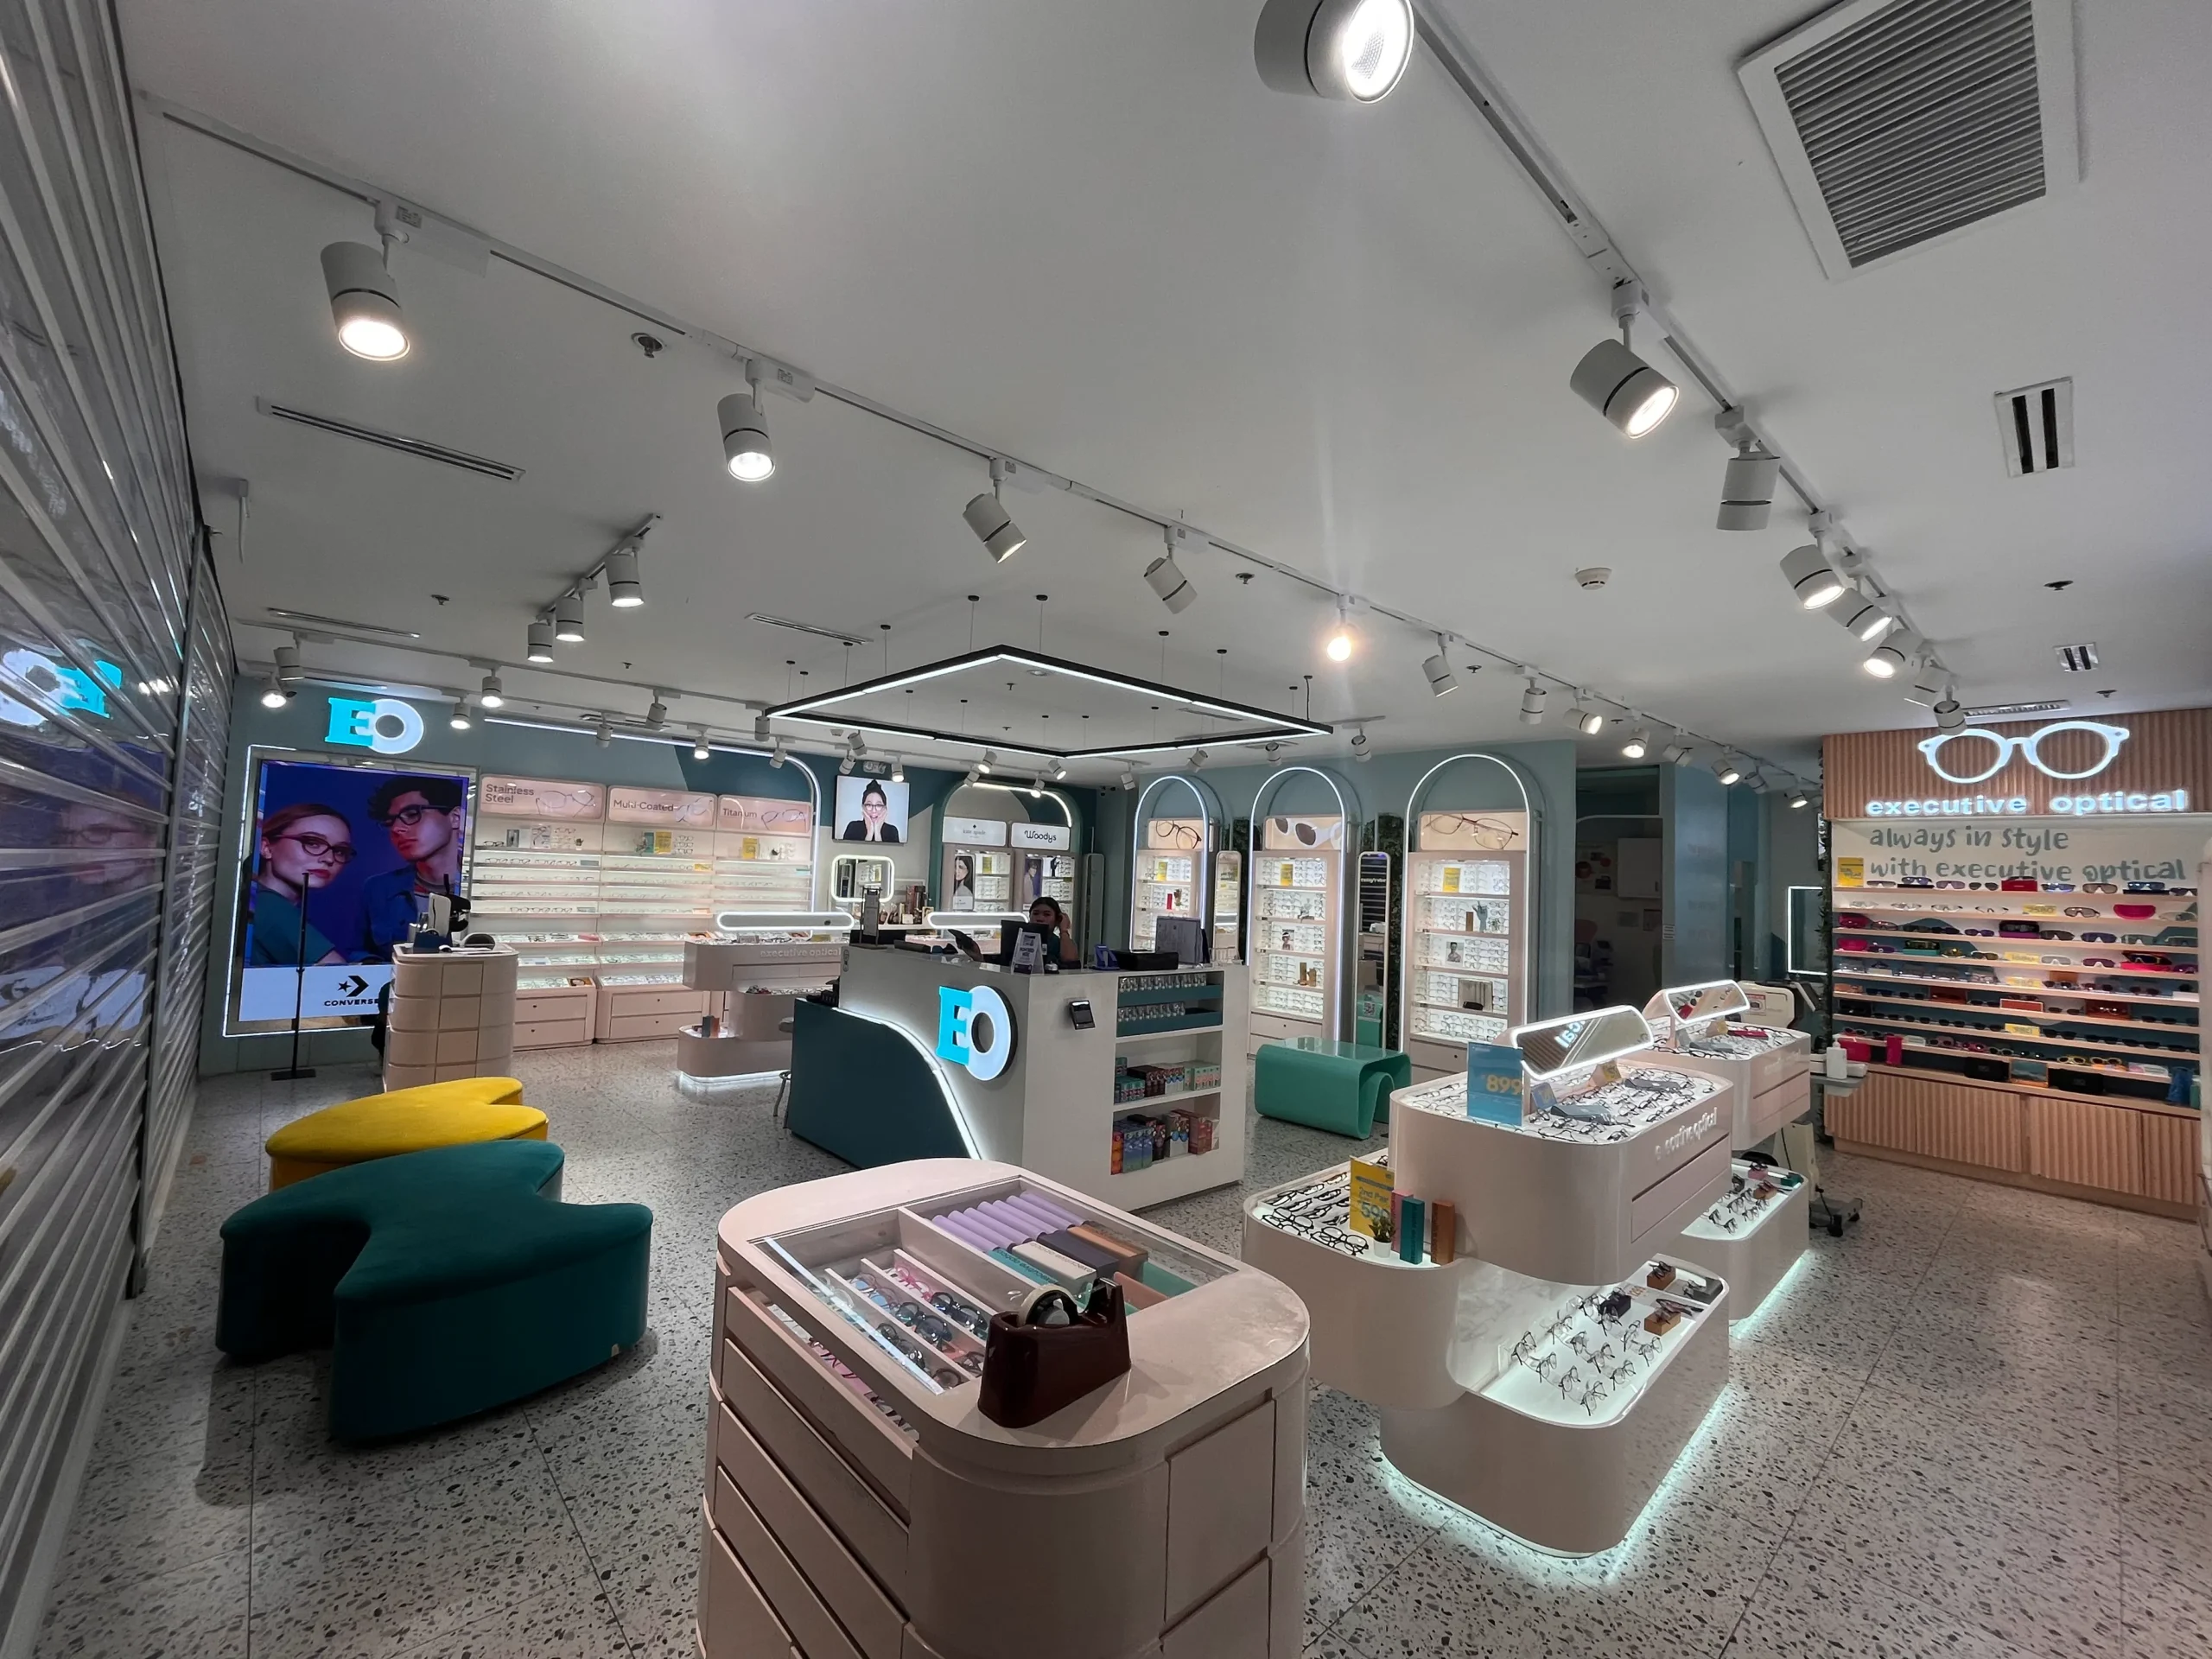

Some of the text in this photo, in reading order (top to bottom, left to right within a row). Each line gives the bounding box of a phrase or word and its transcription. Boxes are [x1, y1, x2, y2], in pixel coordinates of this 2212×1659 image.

[325, 697, 424, 754] EO
[485, 793, 514, 804] Steel
[486, 784, 535, 796] Stainless
[613, 799, 674, 812] Multi-Coated
[1866, 789, 2186, 817] executive optical
[1024, 830, 1057, 843] Woodys
[1870, 828, 1956, 853] always
[1966, 825, 1992, 847] in
[1871, 857, 1927, 877] with
[1936, 860, 2072, 881] executive
[2082, 859, 2187, 883] optical
[760, 947, 842, 958] executive optical
[936, 985, 1014, 1080] EO
[1485, 1074, 1522, 1095] 899
